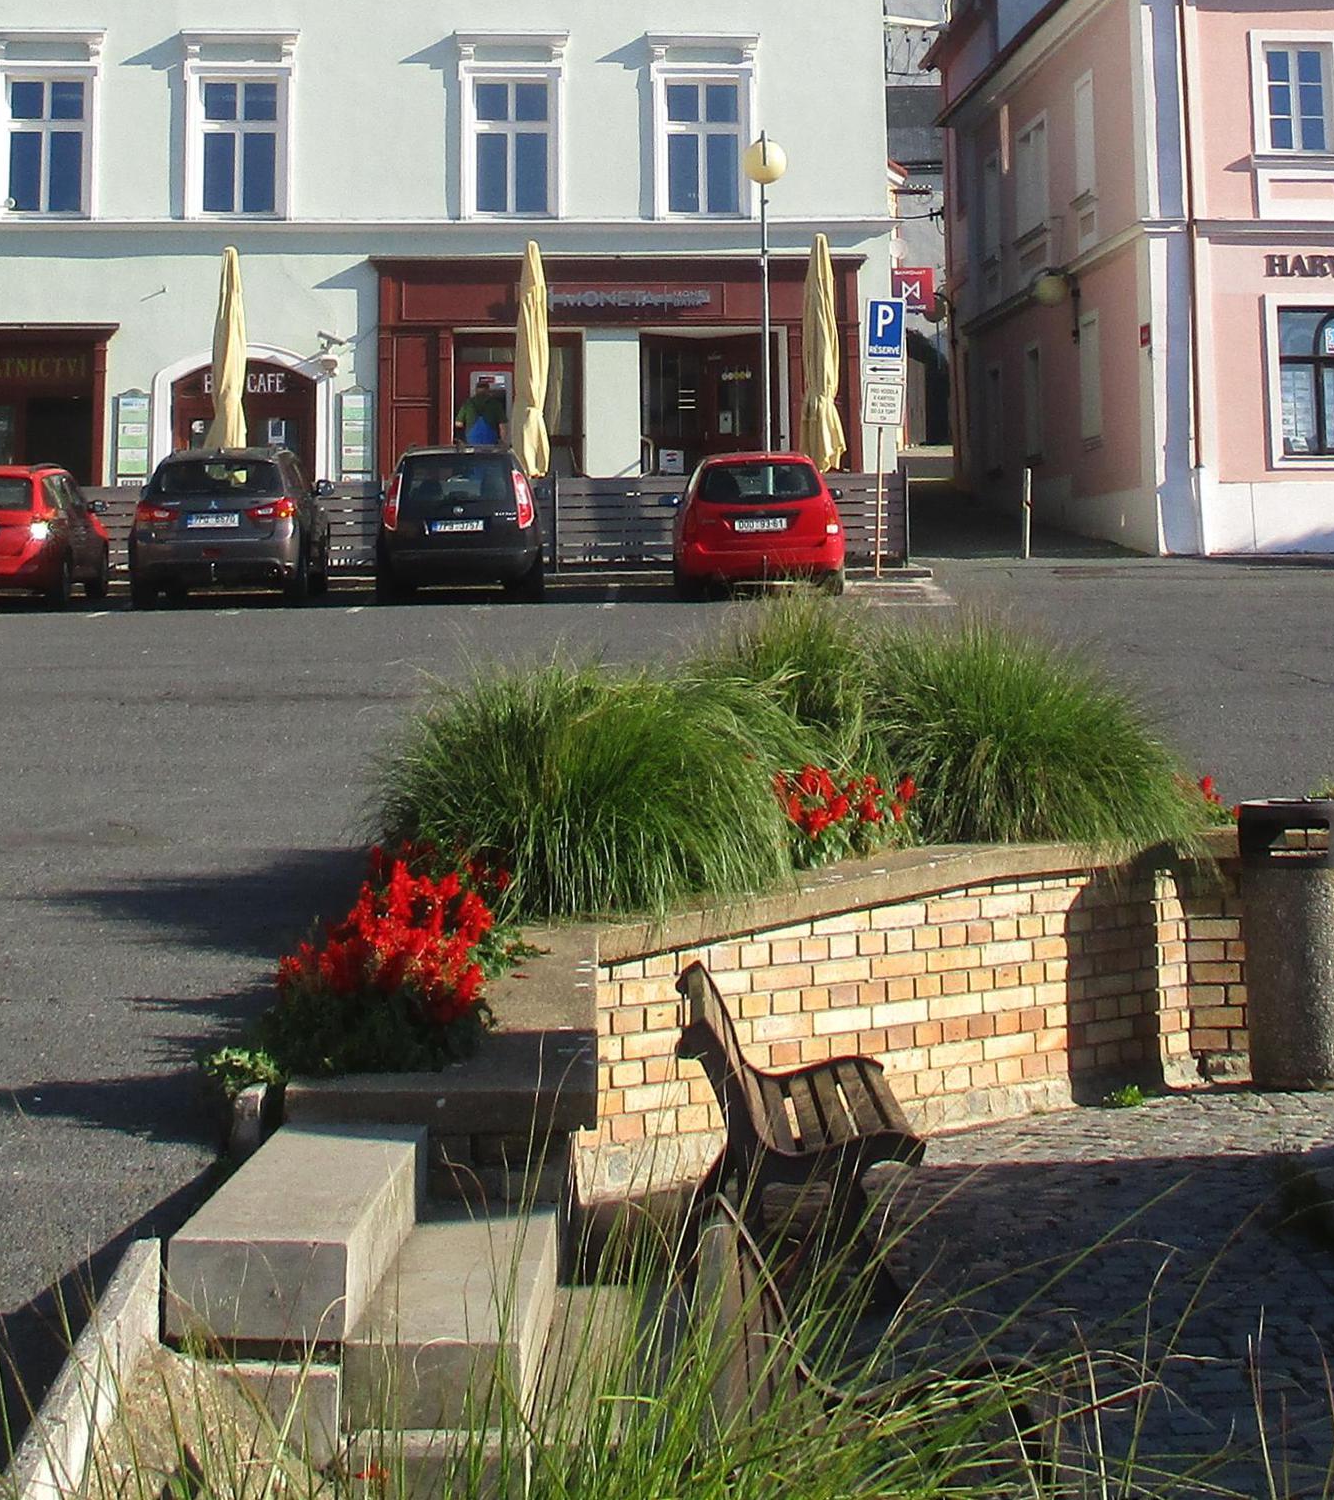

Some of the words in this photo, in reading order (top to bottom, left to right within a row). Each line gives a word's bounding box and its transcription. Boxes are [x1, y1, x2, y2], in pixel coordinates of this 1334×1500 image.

[563, 291, 659, 307] MONETA
[877, 304, 894, 337] P
[247, 373, 285, 393] CAFE
